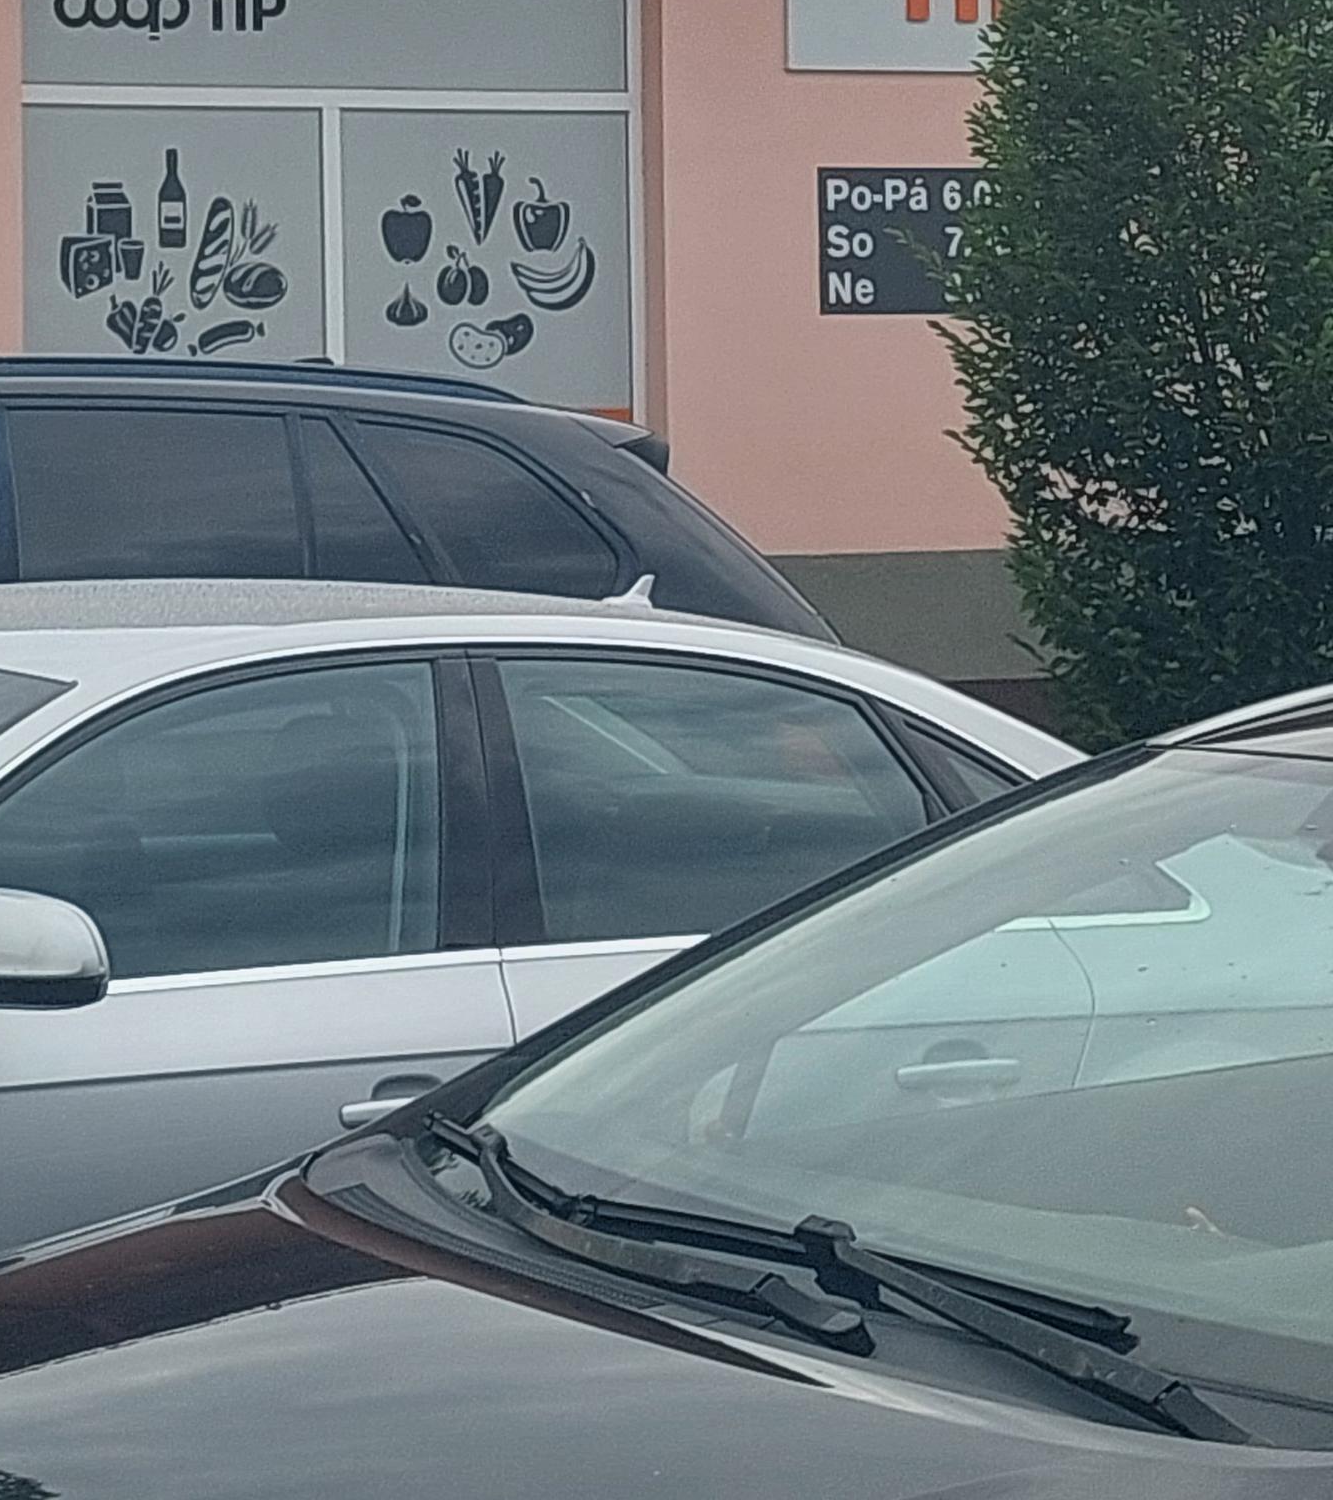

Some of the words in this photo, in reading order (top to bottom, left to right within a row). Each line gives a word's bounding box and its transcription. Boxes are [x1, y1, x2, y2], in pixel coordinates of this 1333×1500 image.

[826, 177, 929, 211] Po-Pá
[826, 224, 874, 258] So
[827, 271, 875, 305] Ne
